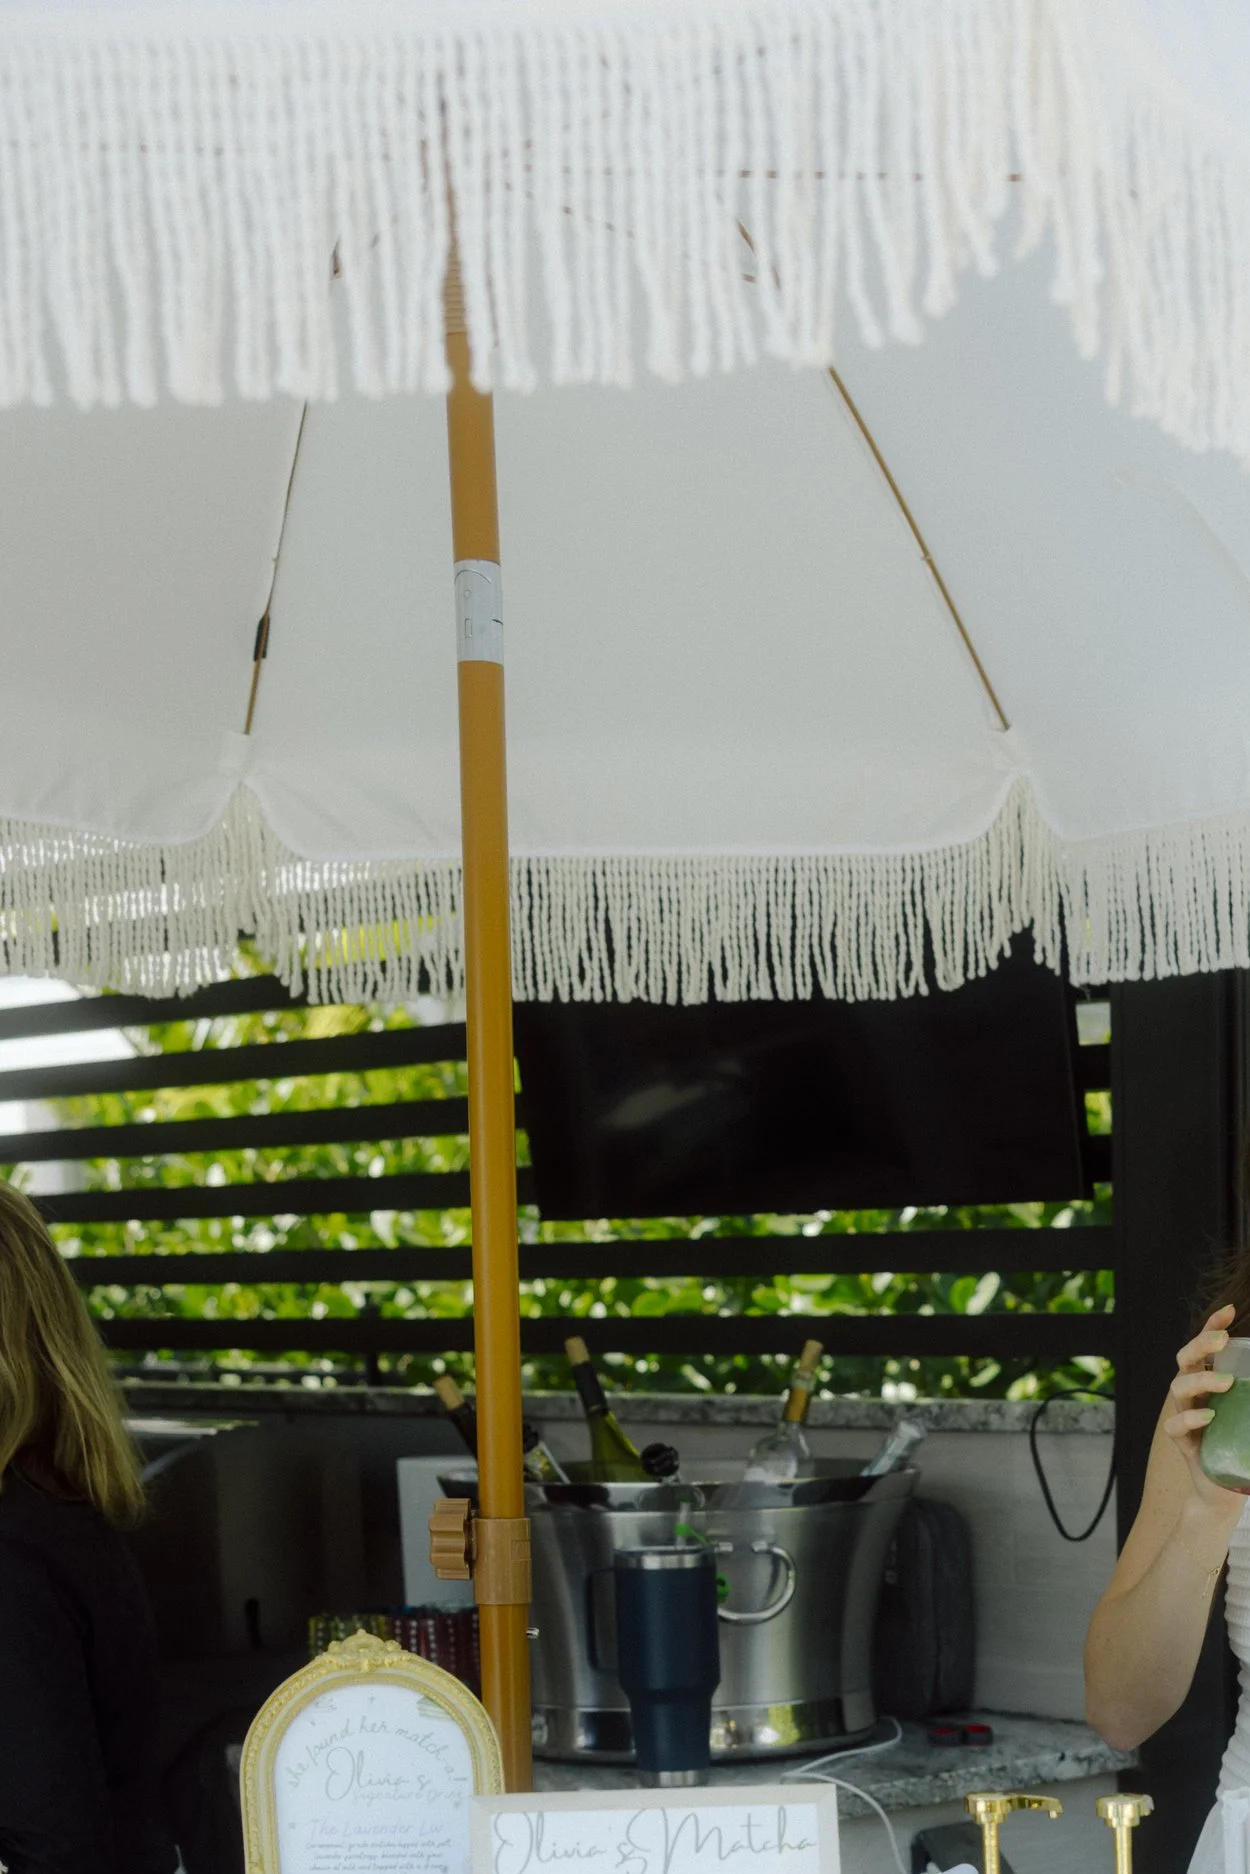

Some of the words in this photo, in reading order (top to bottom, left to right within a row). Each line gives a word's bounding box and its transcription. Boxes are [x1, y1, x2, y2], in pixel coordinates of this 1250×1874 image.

[359, 1715, 392, 1734] her
[308, 1818, 339, 1840] The
[342, 1816, 412, 1838] Lavender
